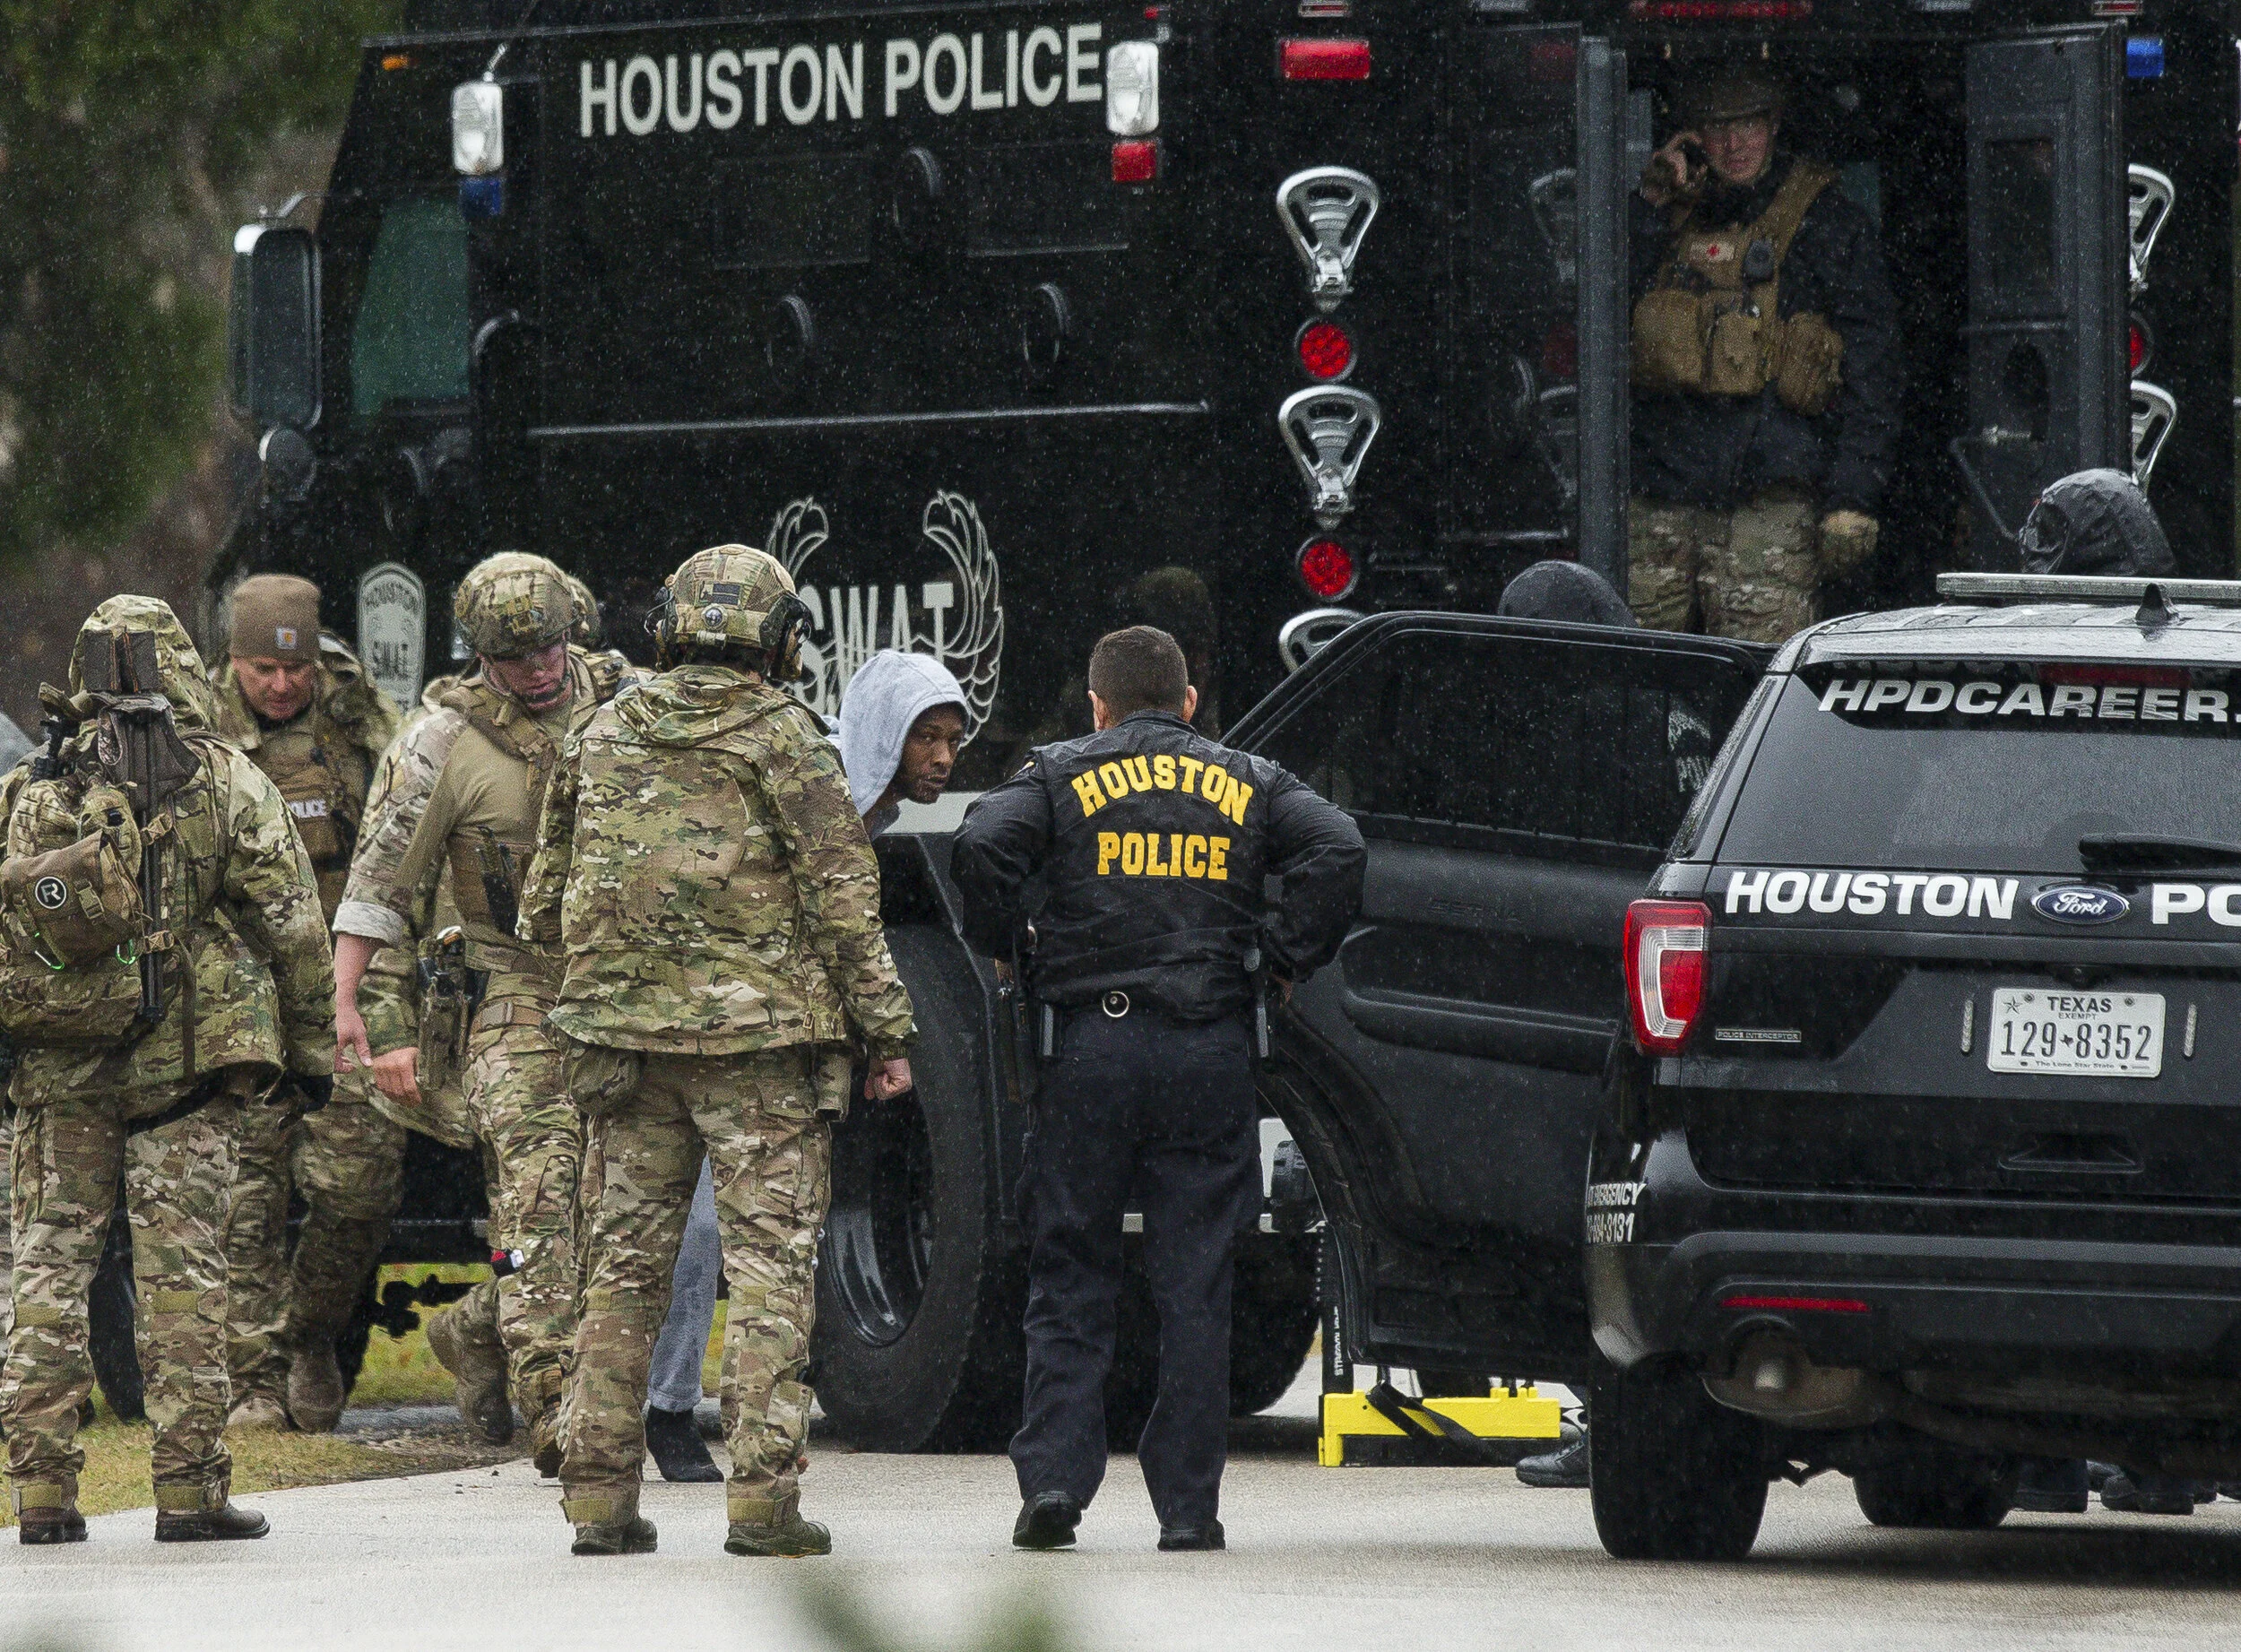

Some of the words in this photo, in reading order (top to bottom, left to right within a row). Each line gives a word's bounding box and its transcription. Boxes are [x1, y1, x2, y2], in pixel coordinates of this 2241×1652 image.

[580, 41, 863, 138] HOUSTON
[885, 22, 1103, 117] POLICE
[1071, 754, 1253, 826] HOUSTON
[1097, 832, 1231, 880] POLICE
[1726, 871, 2020, 920] HOUSTON
[2053, 892, 2108, 915] Ford
[2047, 996, 2113, 1013] TEXAS
[2058, 1012, 2098, 1020] EXEMPT
[1745, 1032, 1798, 1040] INTERCEPTOR
